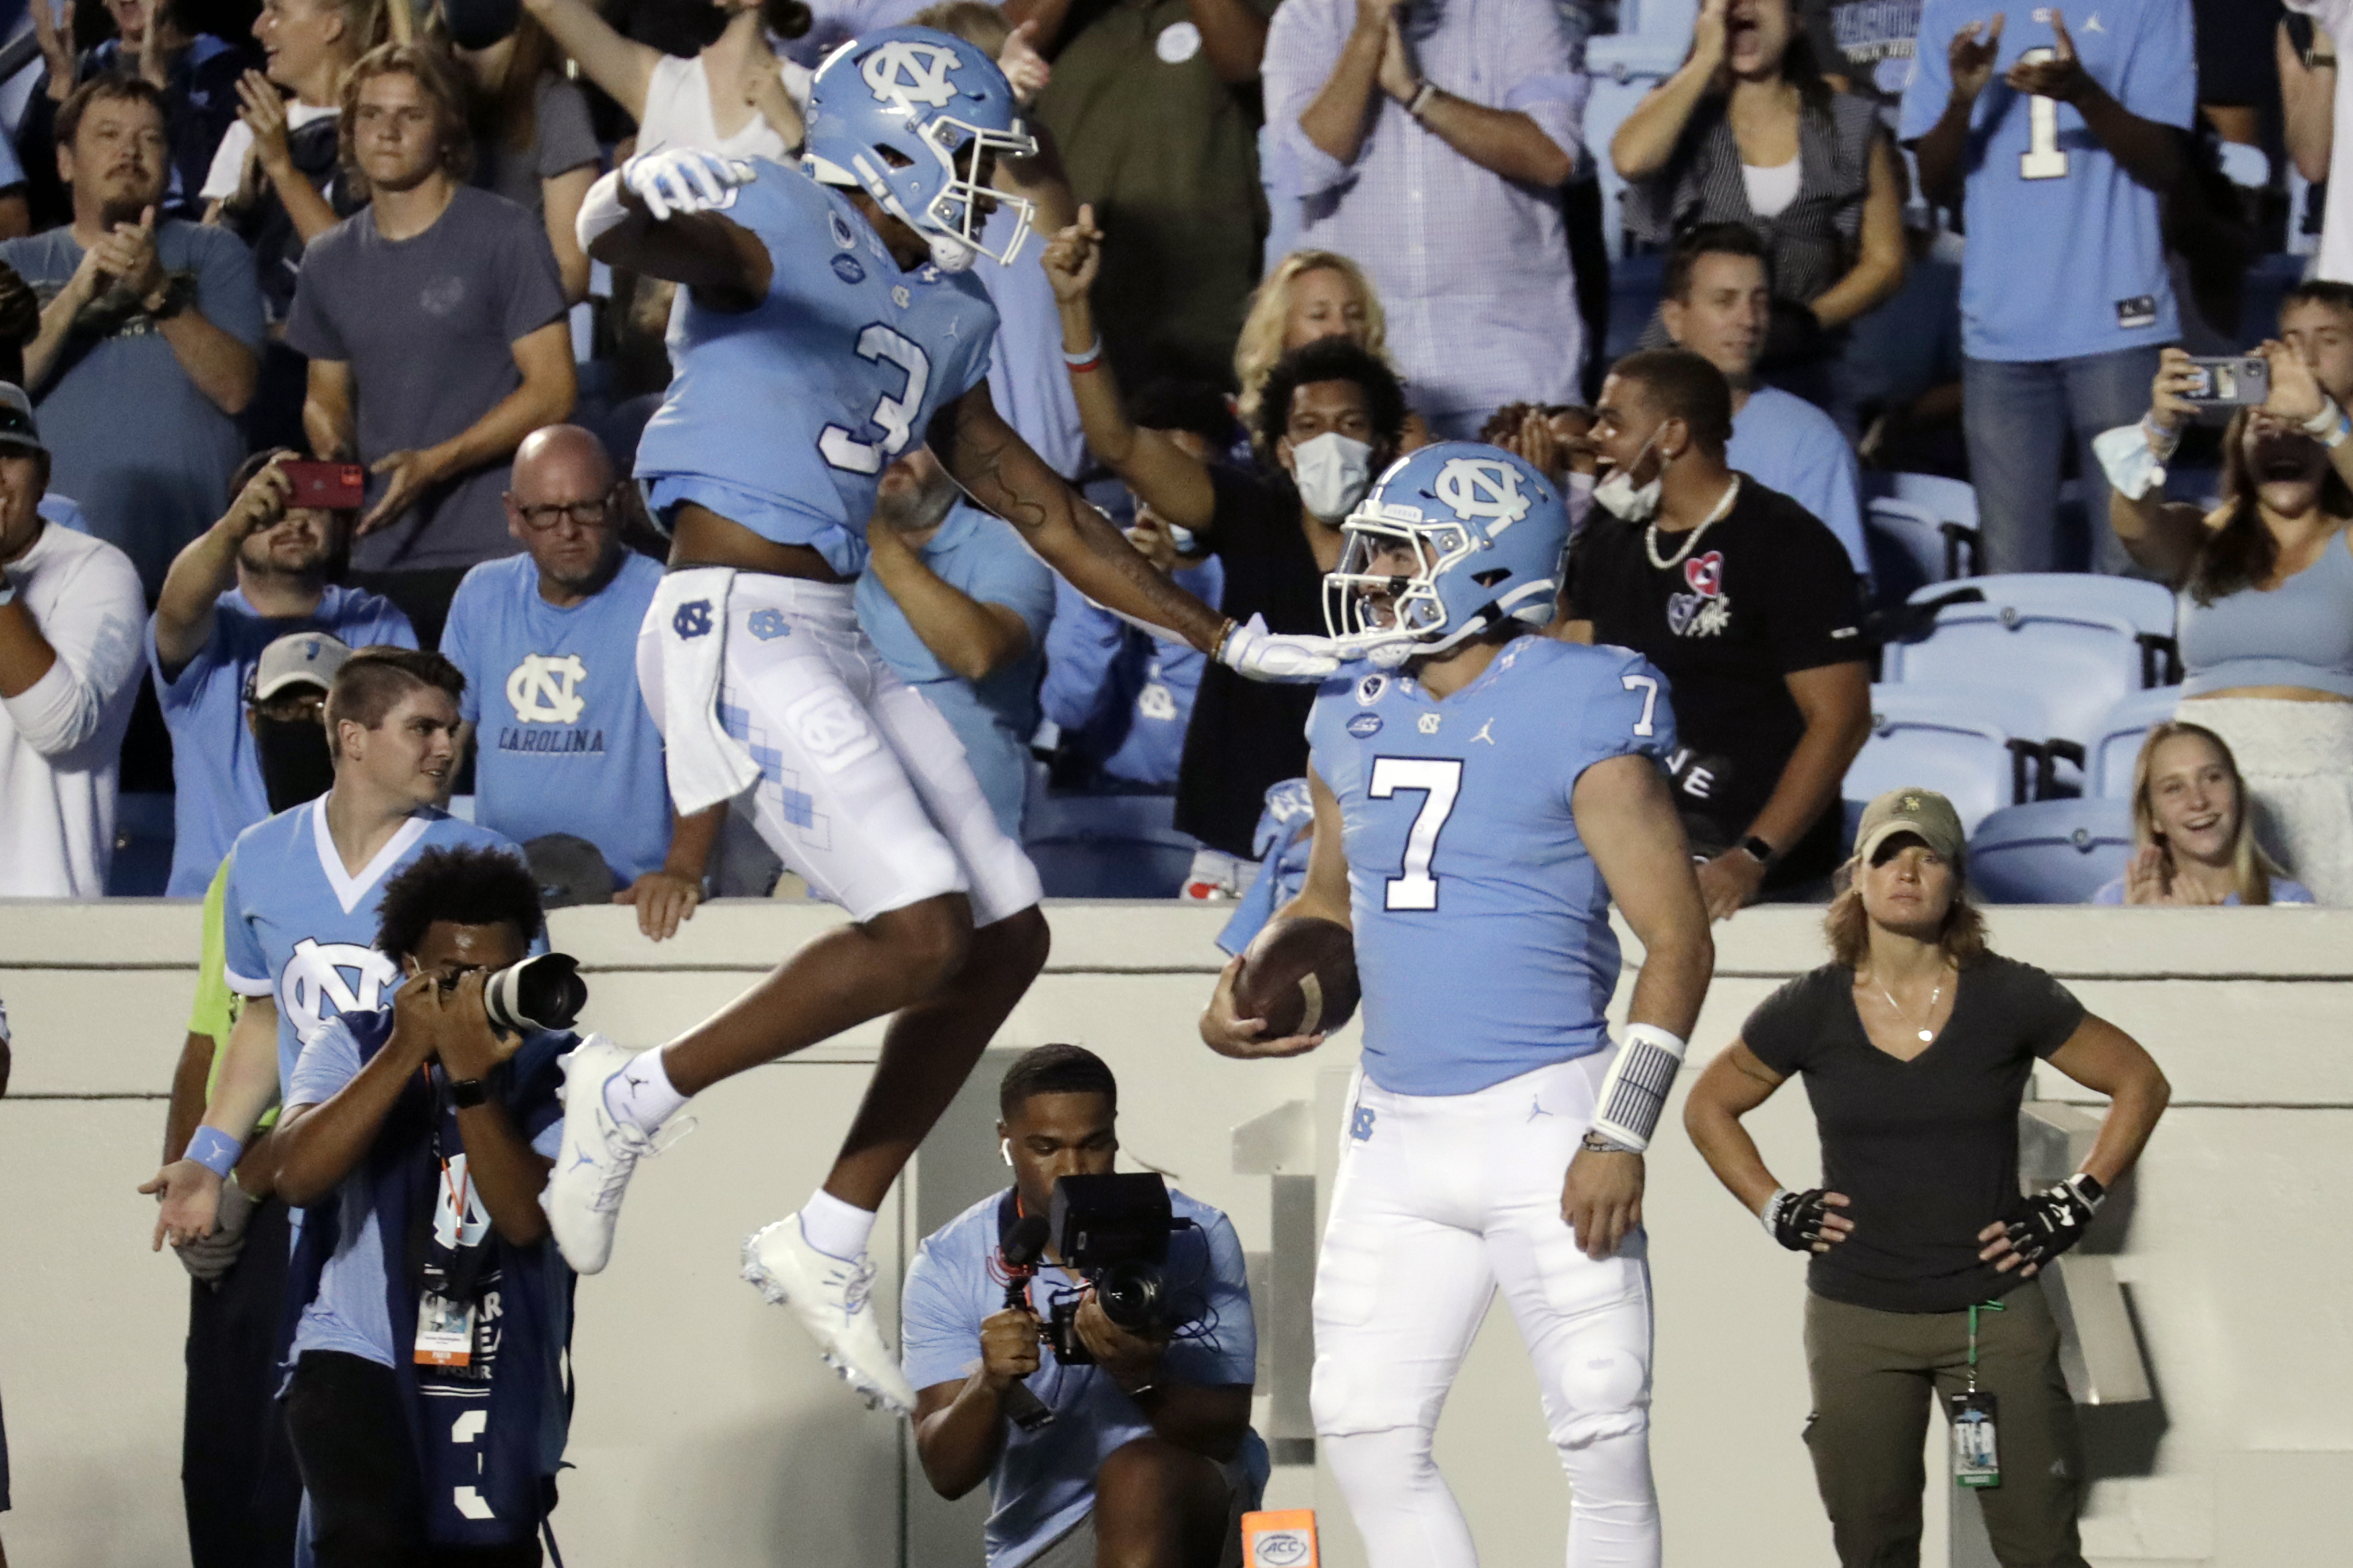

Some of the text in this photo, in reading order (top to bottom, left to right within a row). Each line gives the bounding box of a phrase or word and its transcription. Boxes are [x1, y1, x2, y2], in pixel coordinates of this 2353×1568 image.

[818, 321, 932, 477] 3
[1622, 674, 1659, 737] 7
[498, 727, 605, 753] CAROLINA
[1367, 754, 1464, 913] 7
[1264, 1542, 1299, 1553] ACC
